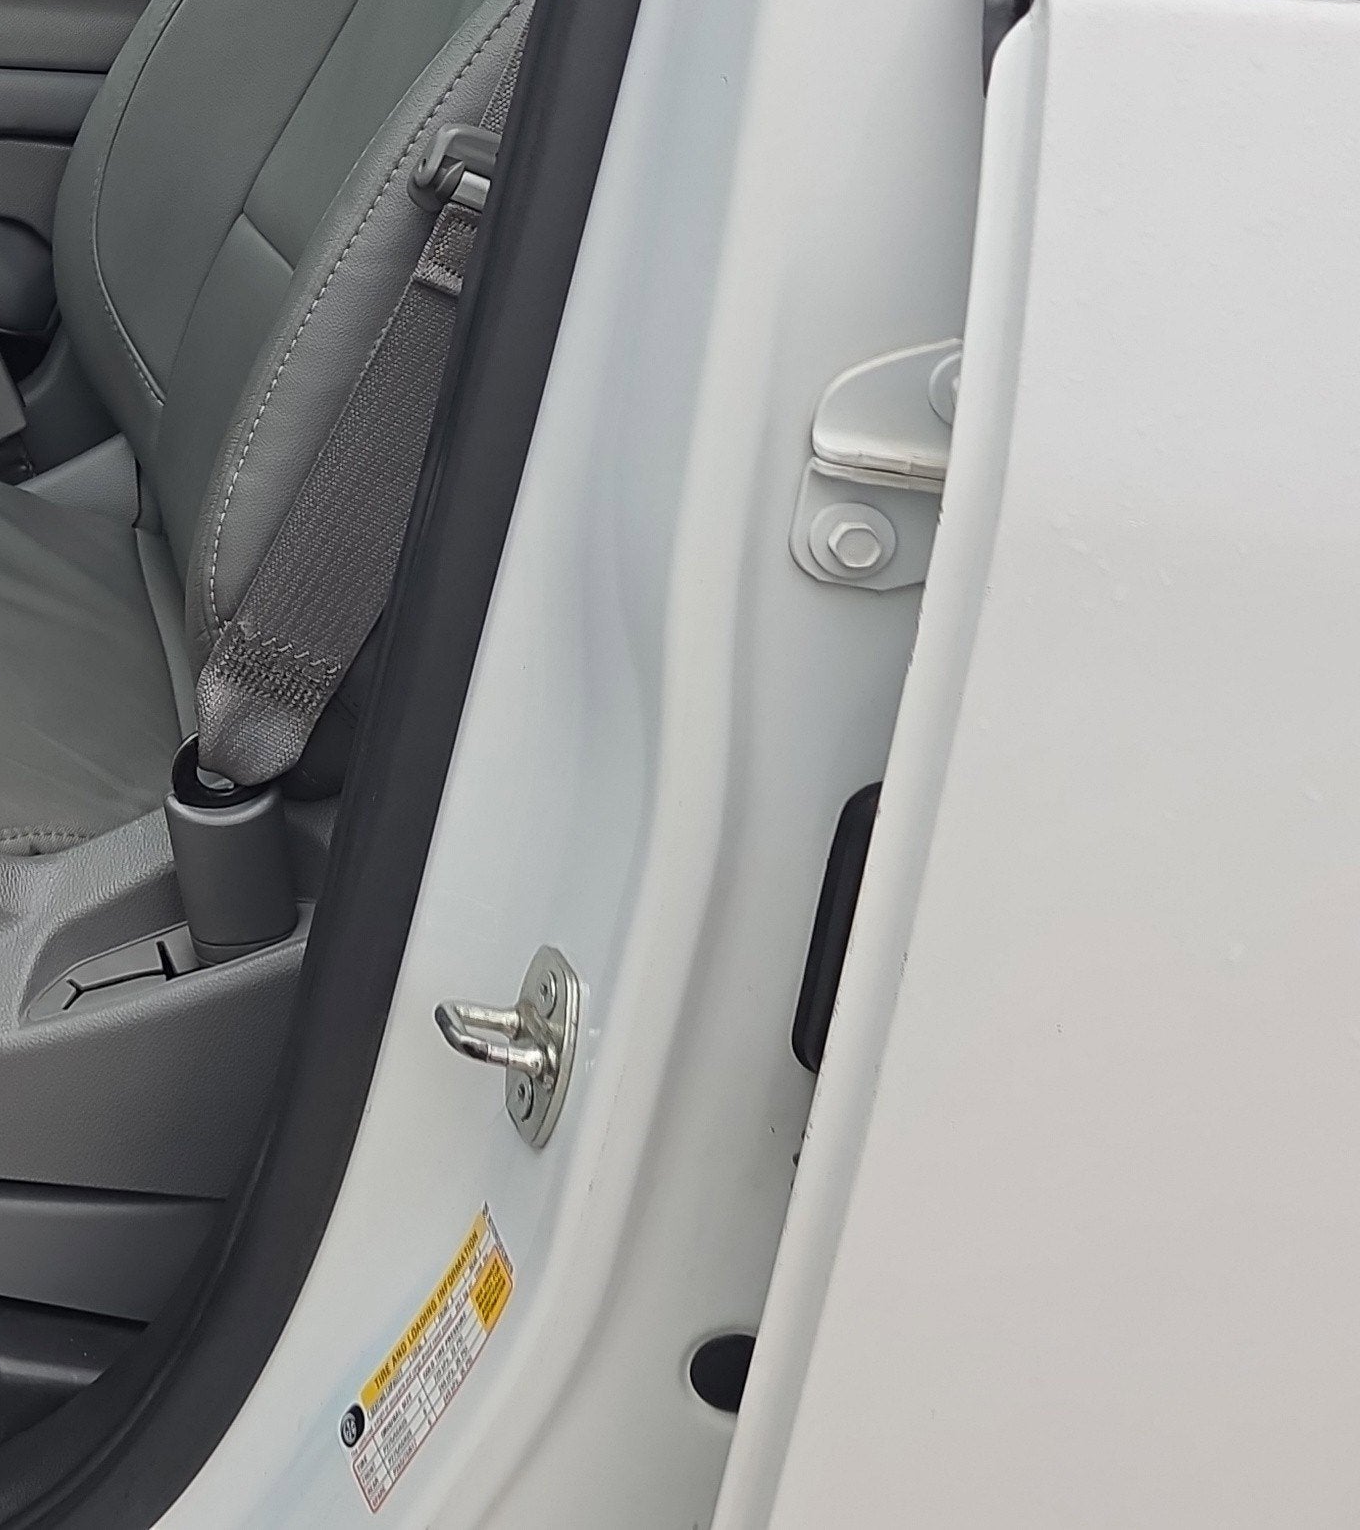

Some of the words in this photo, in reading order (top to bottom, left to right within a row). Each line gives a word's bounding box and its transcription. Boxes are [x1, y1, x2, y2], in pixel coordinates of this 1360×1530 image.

[374, 1362, 391, 1390] TIRE
[391, 1341, 408, 1369] AND
[406, 1299, 438, 1346] LOADING
[436, 1230, 479, 1302] INFORMATION
